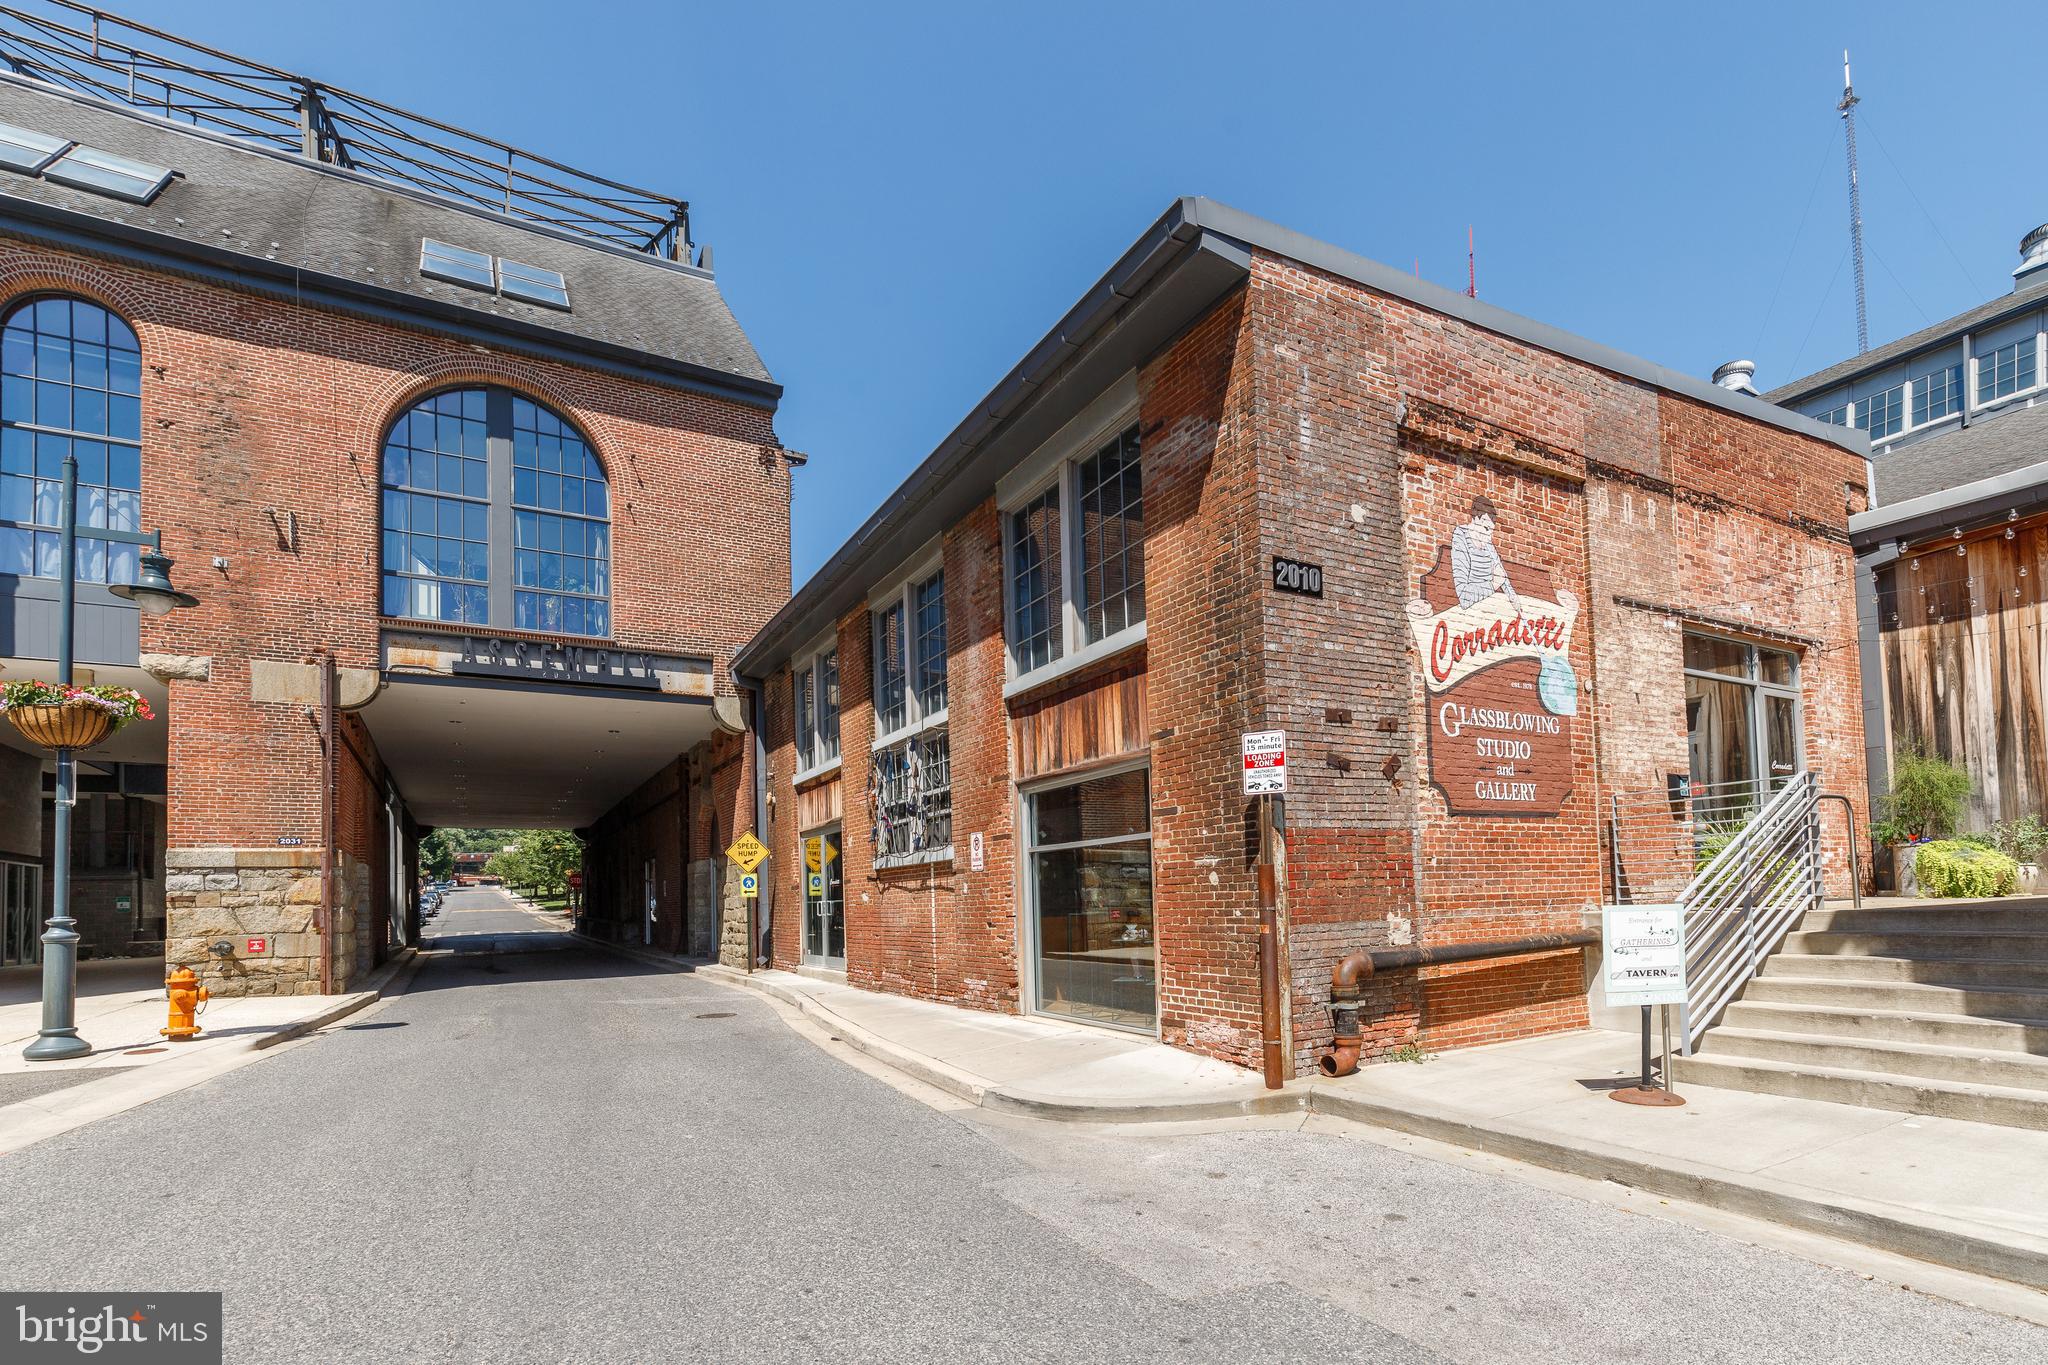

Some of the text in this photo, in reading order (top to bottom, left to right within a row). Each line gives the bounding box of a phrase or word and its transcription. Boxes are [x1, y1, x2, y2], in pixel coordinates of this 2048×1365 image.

[1276, 561, 1320, 592] 2010
[1431, 611, 1565, 683] Corradetti
[463, 637, 652, 679] ASSEMBLY
[1440, 702, 1560, 737] GLASSBLOWING
[1247, 752, 1282, 762] LOADING
[1476, 738, 1531, 759] STUDIO
[1254, 760, 1275, 768] ZONE
[1496, 762, 1515, 776] and
[1475, 781, 1537, 801] GALLERY
[1620, 938, 1671, 946] GATHERINGS
[1626, 969, 1667, 977] TAVERN
